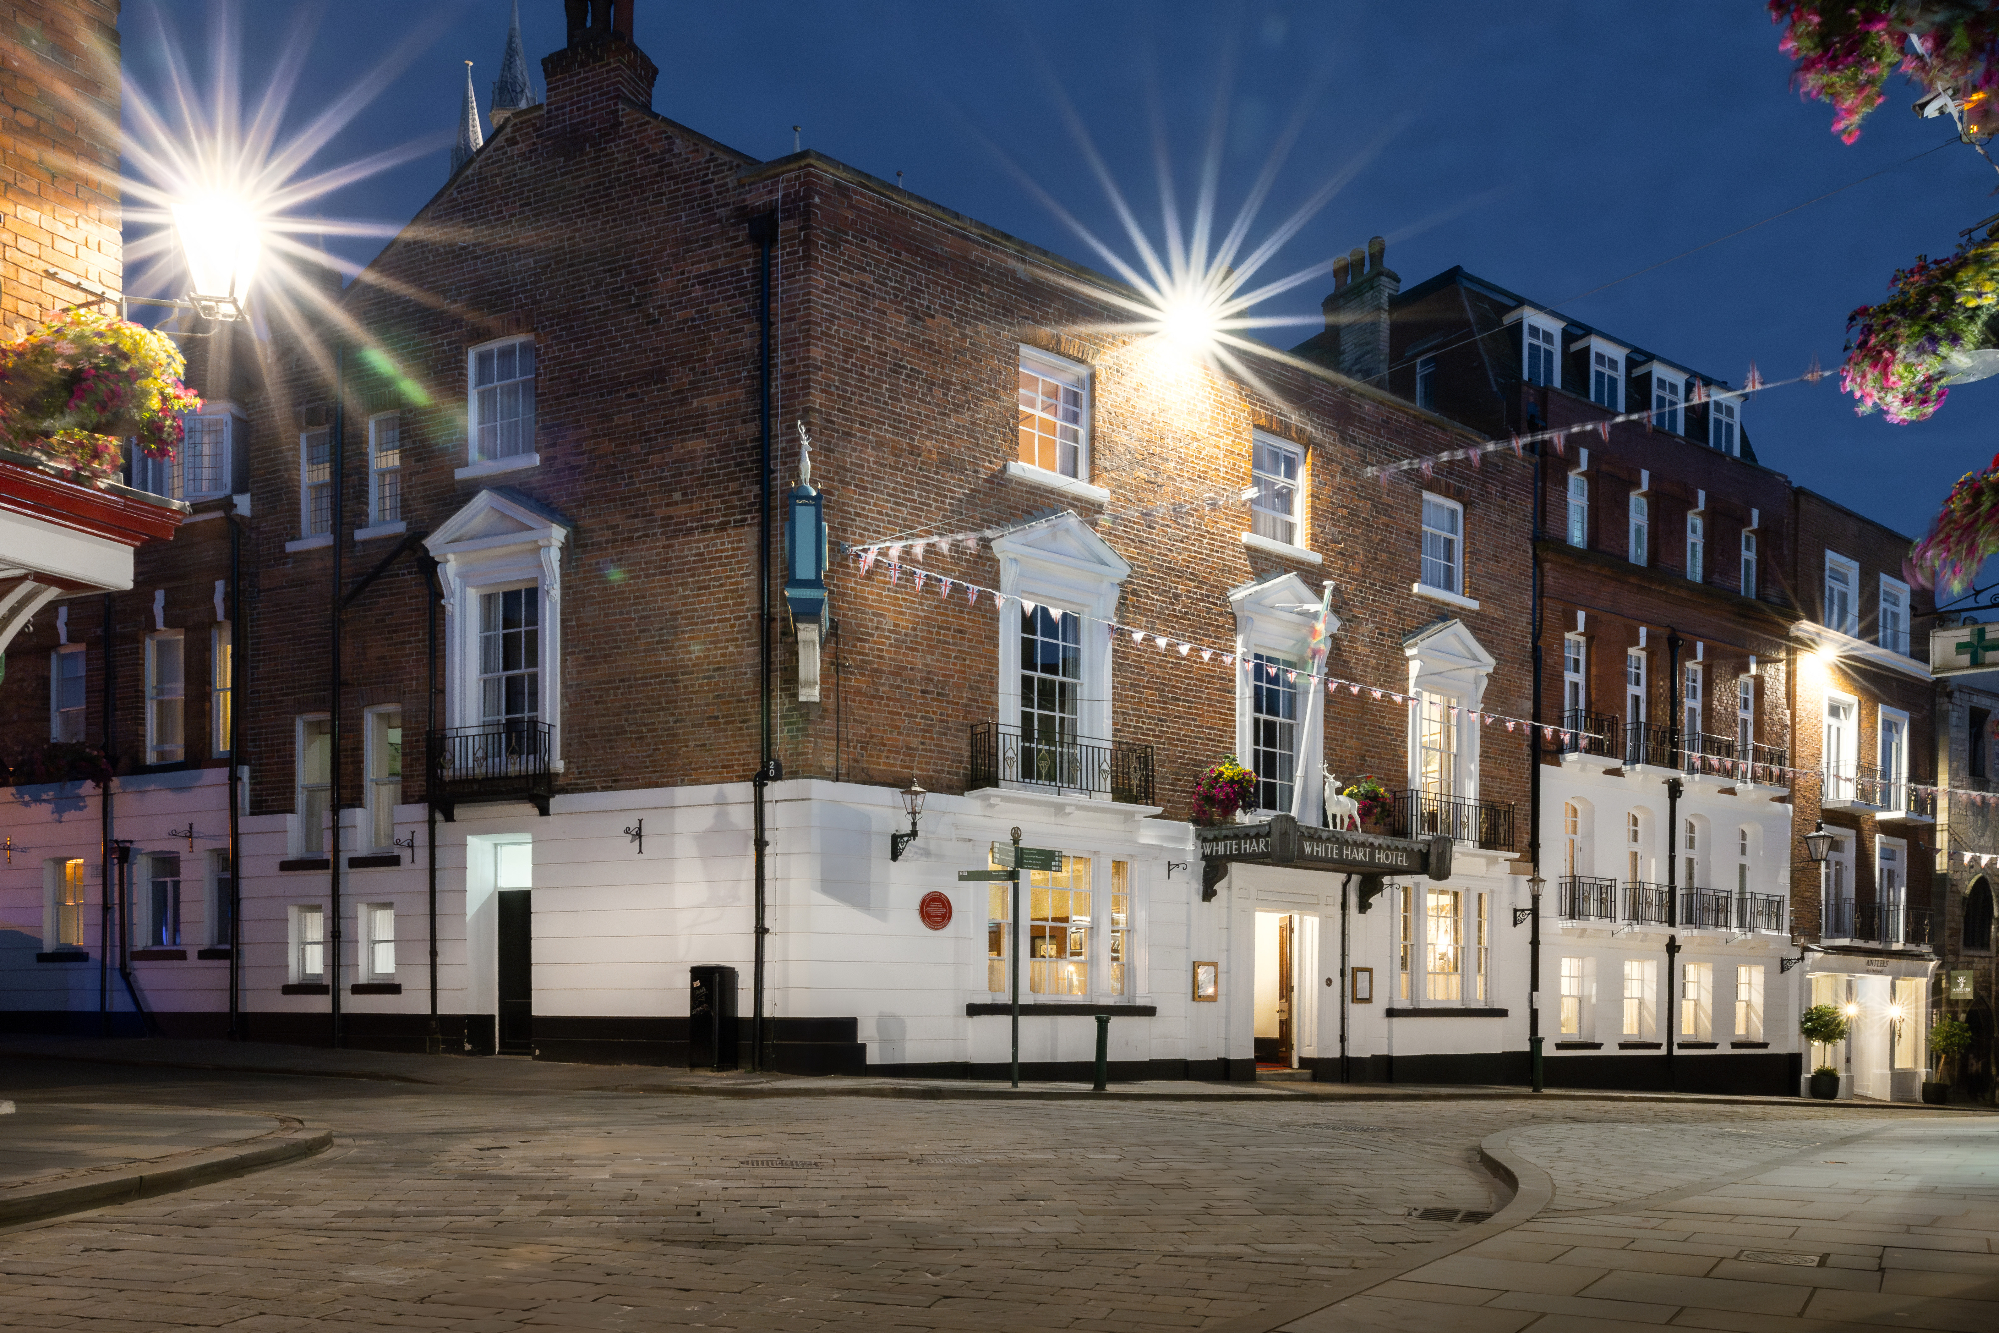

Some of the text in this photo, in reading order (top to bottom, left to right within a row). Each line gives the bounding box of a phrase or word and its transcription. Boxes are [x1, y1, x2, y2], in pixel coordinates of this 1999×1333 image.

[1203, 838, 1271, 856] WHITE HART
[1303, 841, 1409, 866] WHITE HART HOTEL
